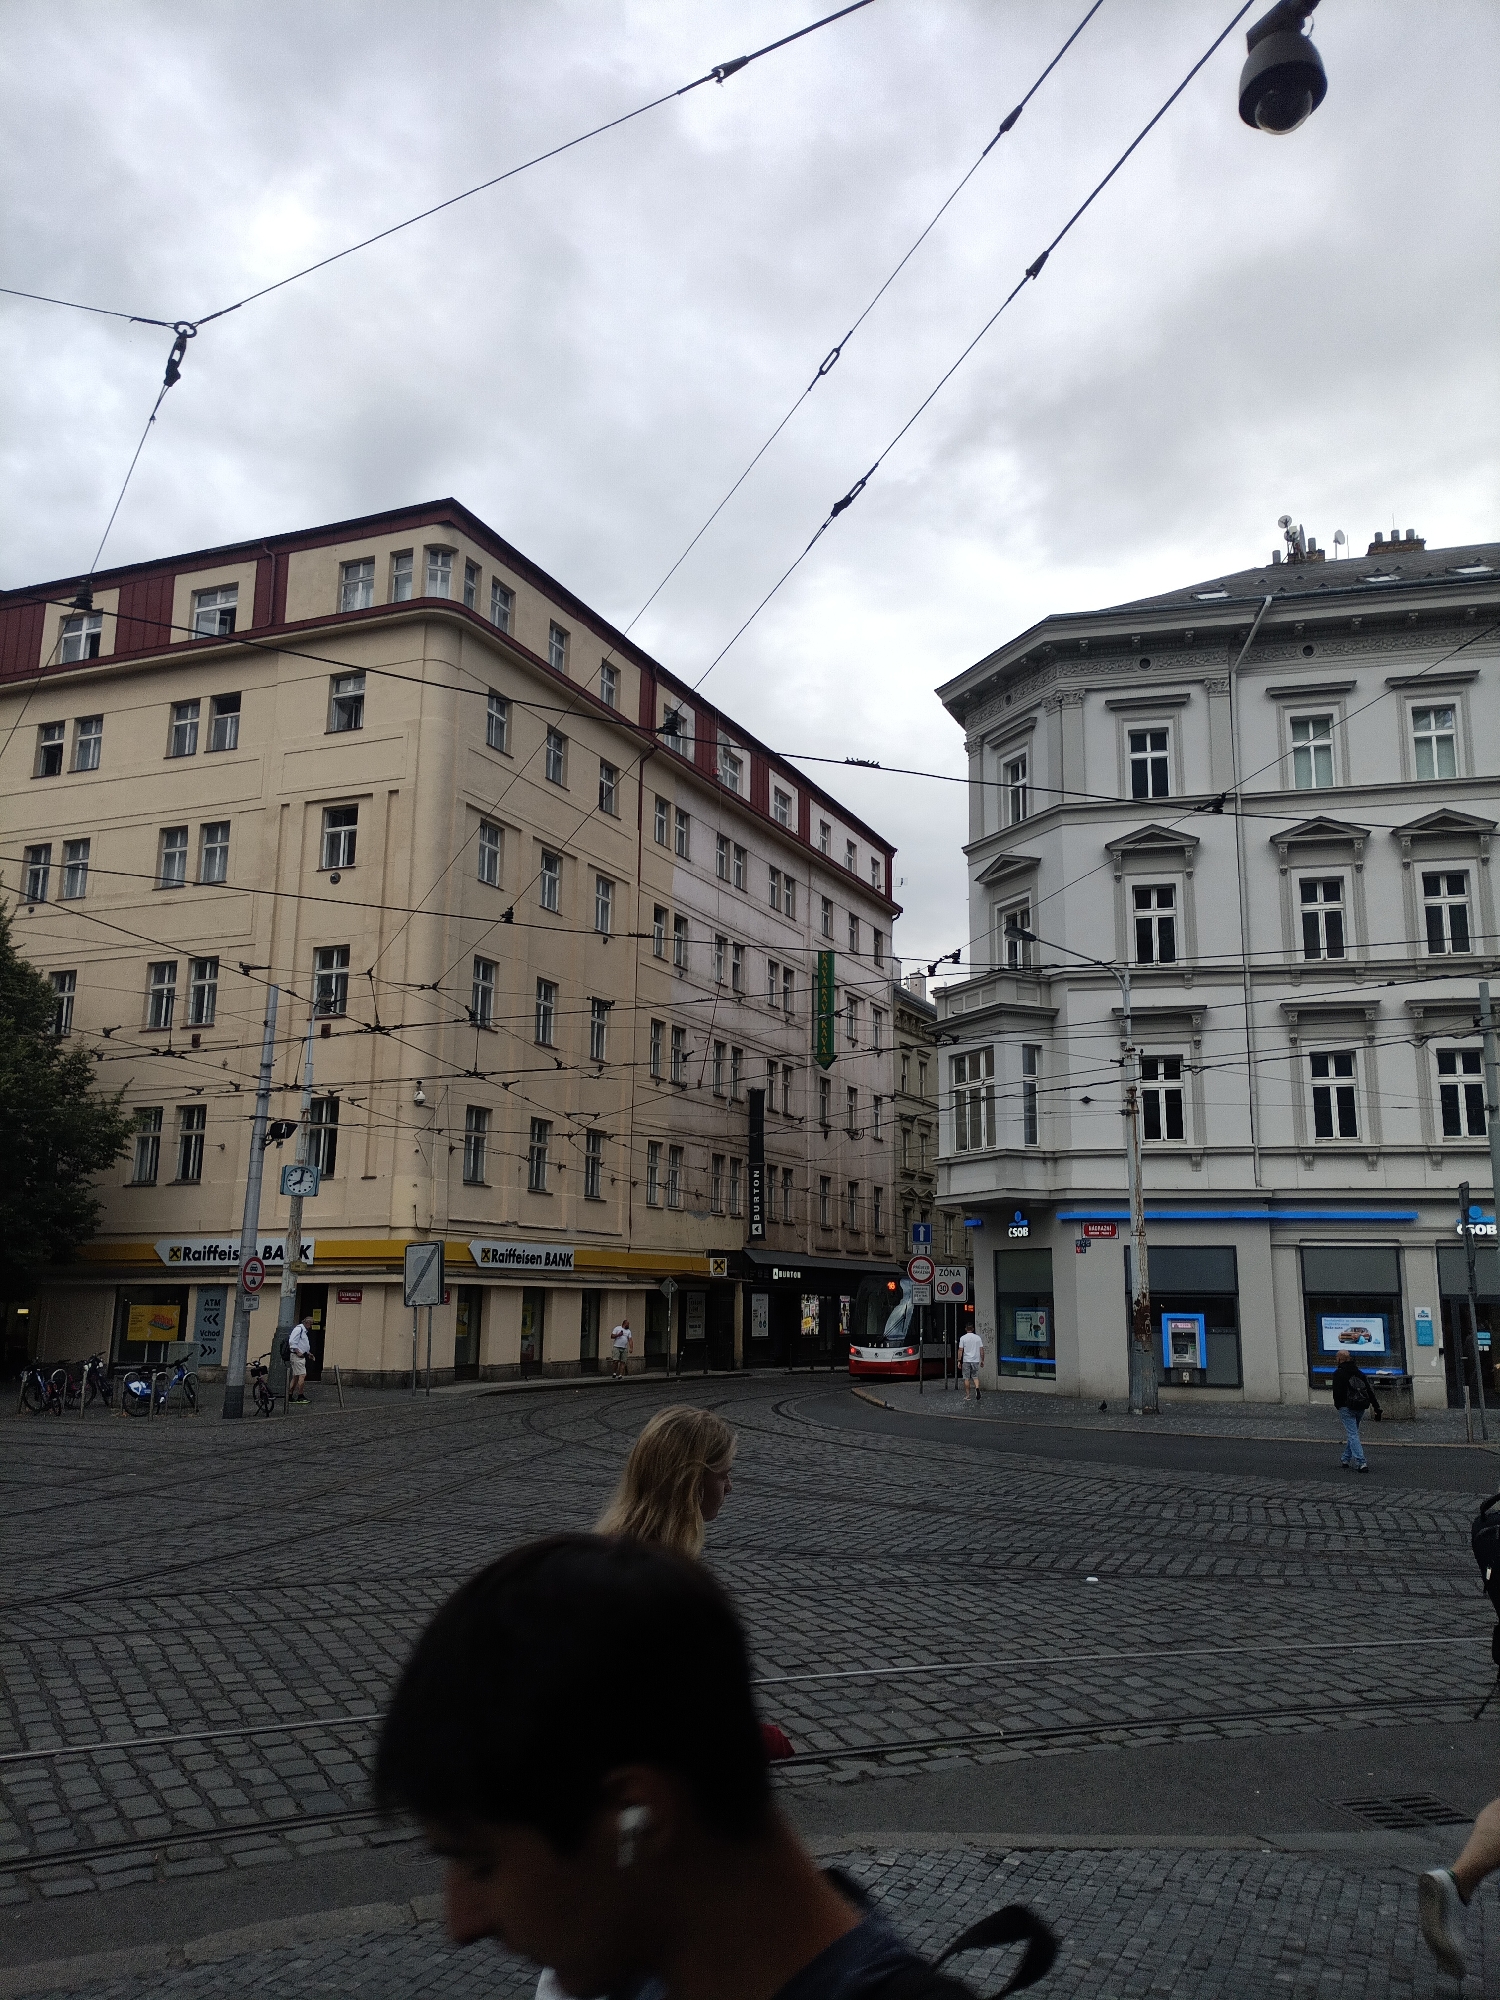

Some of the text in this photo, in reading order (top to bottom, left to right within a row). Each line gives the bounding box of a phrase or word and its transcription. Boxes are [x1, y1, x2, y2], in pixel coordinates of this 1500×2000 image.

[183, 1245, 311, 1261] Raiffeis BAK
[491, 1248, 573, 1267] Raiffeisen BANK
[778, 1270, 801, 1279] BURTON
[938, 1268, 961, 1277] ZÓNA
[204, 1299, 221, 1307] ATM
